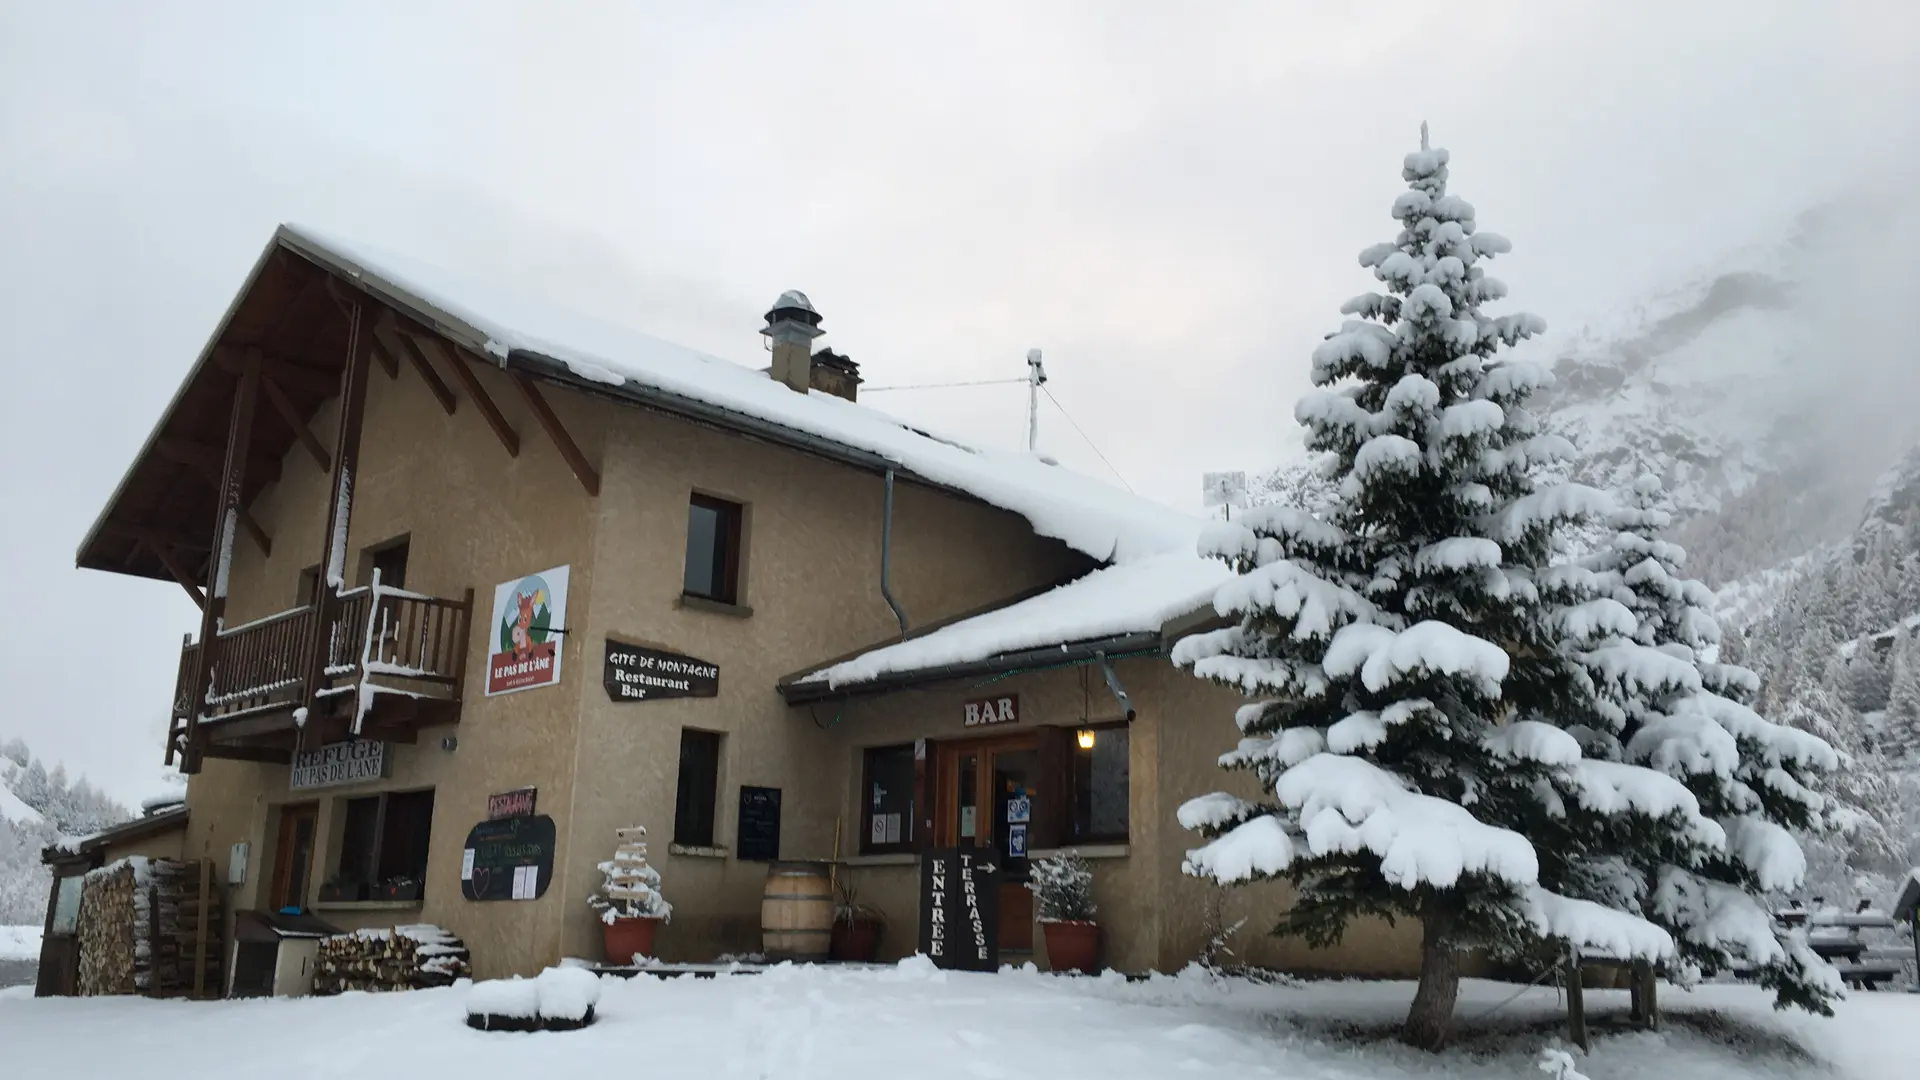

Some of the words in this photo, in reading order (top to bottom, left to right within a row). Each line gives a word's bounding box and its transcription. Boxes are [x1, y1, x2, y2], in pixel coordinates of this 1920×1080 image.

[495, 667, 503, 679] LE
[504, 664, 517, 677] PAS
[518, 661, 529, 674] DE
[609, 652, 637, 666] GITE
[640, 656, 655, 669] DE
[657, 660, 717, 679] MONTAGNE
[615, 668, 690, 691] Restaurant
[621, 684, 647, 699] Bar
[964, 698, 1015, 726] BAR
[296, 740, 381, 768] REFUGE
[293, 768, 308, 787] DU
[308, 765, 328, 785] PAS
[329, 762, 346, 781] DE
[931, 859, 946, 956] ENTREE
[960, 854, 988, 960] TERRASSE
